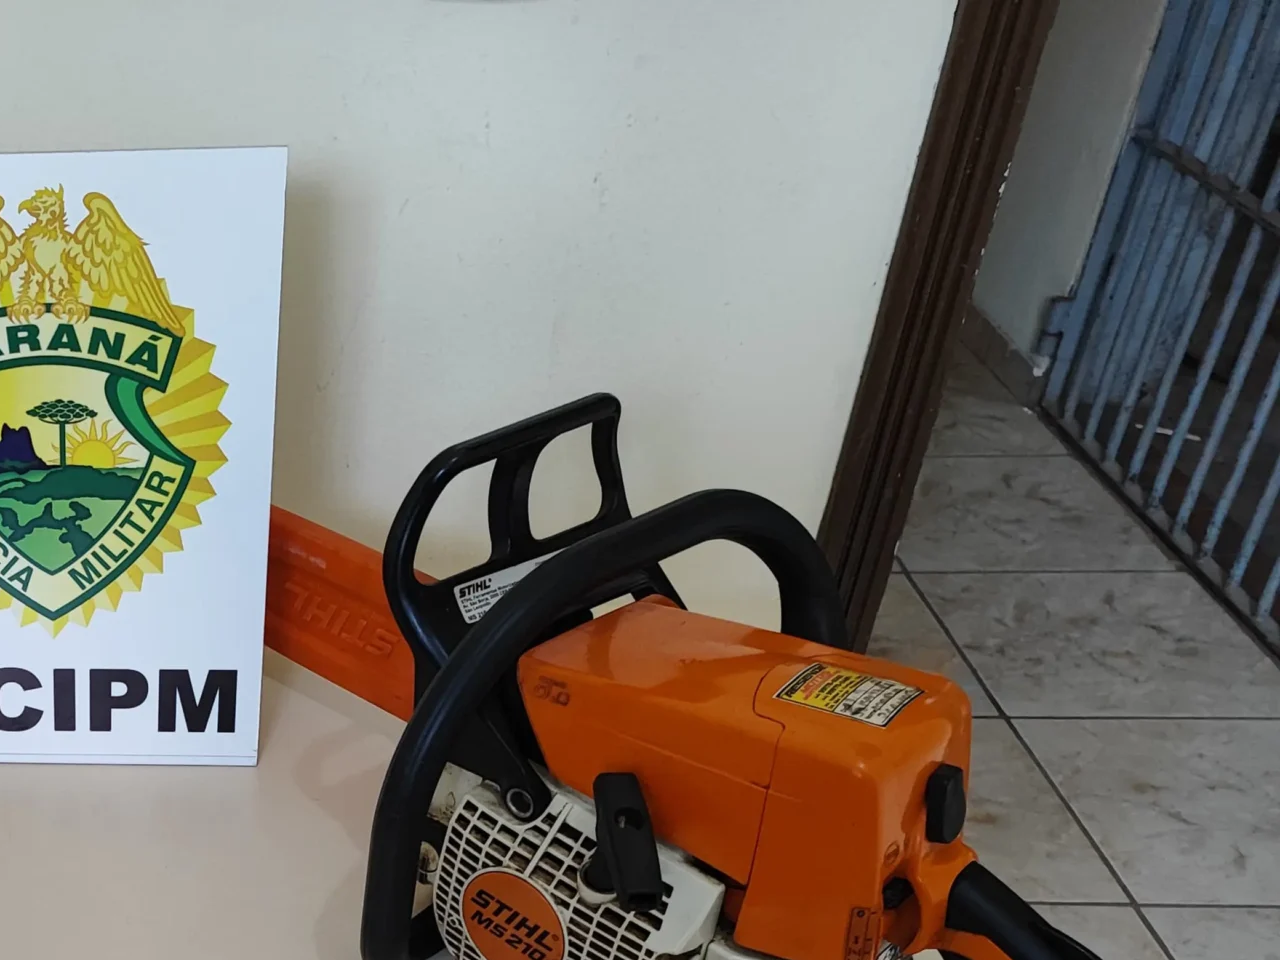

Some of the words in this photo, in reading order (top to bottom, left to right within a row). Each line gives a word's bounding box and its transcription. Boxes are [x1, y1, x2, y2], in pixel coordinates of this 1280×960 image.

[68, 470, 177, 591] MILITAR
[284, 581, 400, 657] STIHL
[458, 578, 492, 599] STIHL
[470, 888, 554, 952] STIHL
